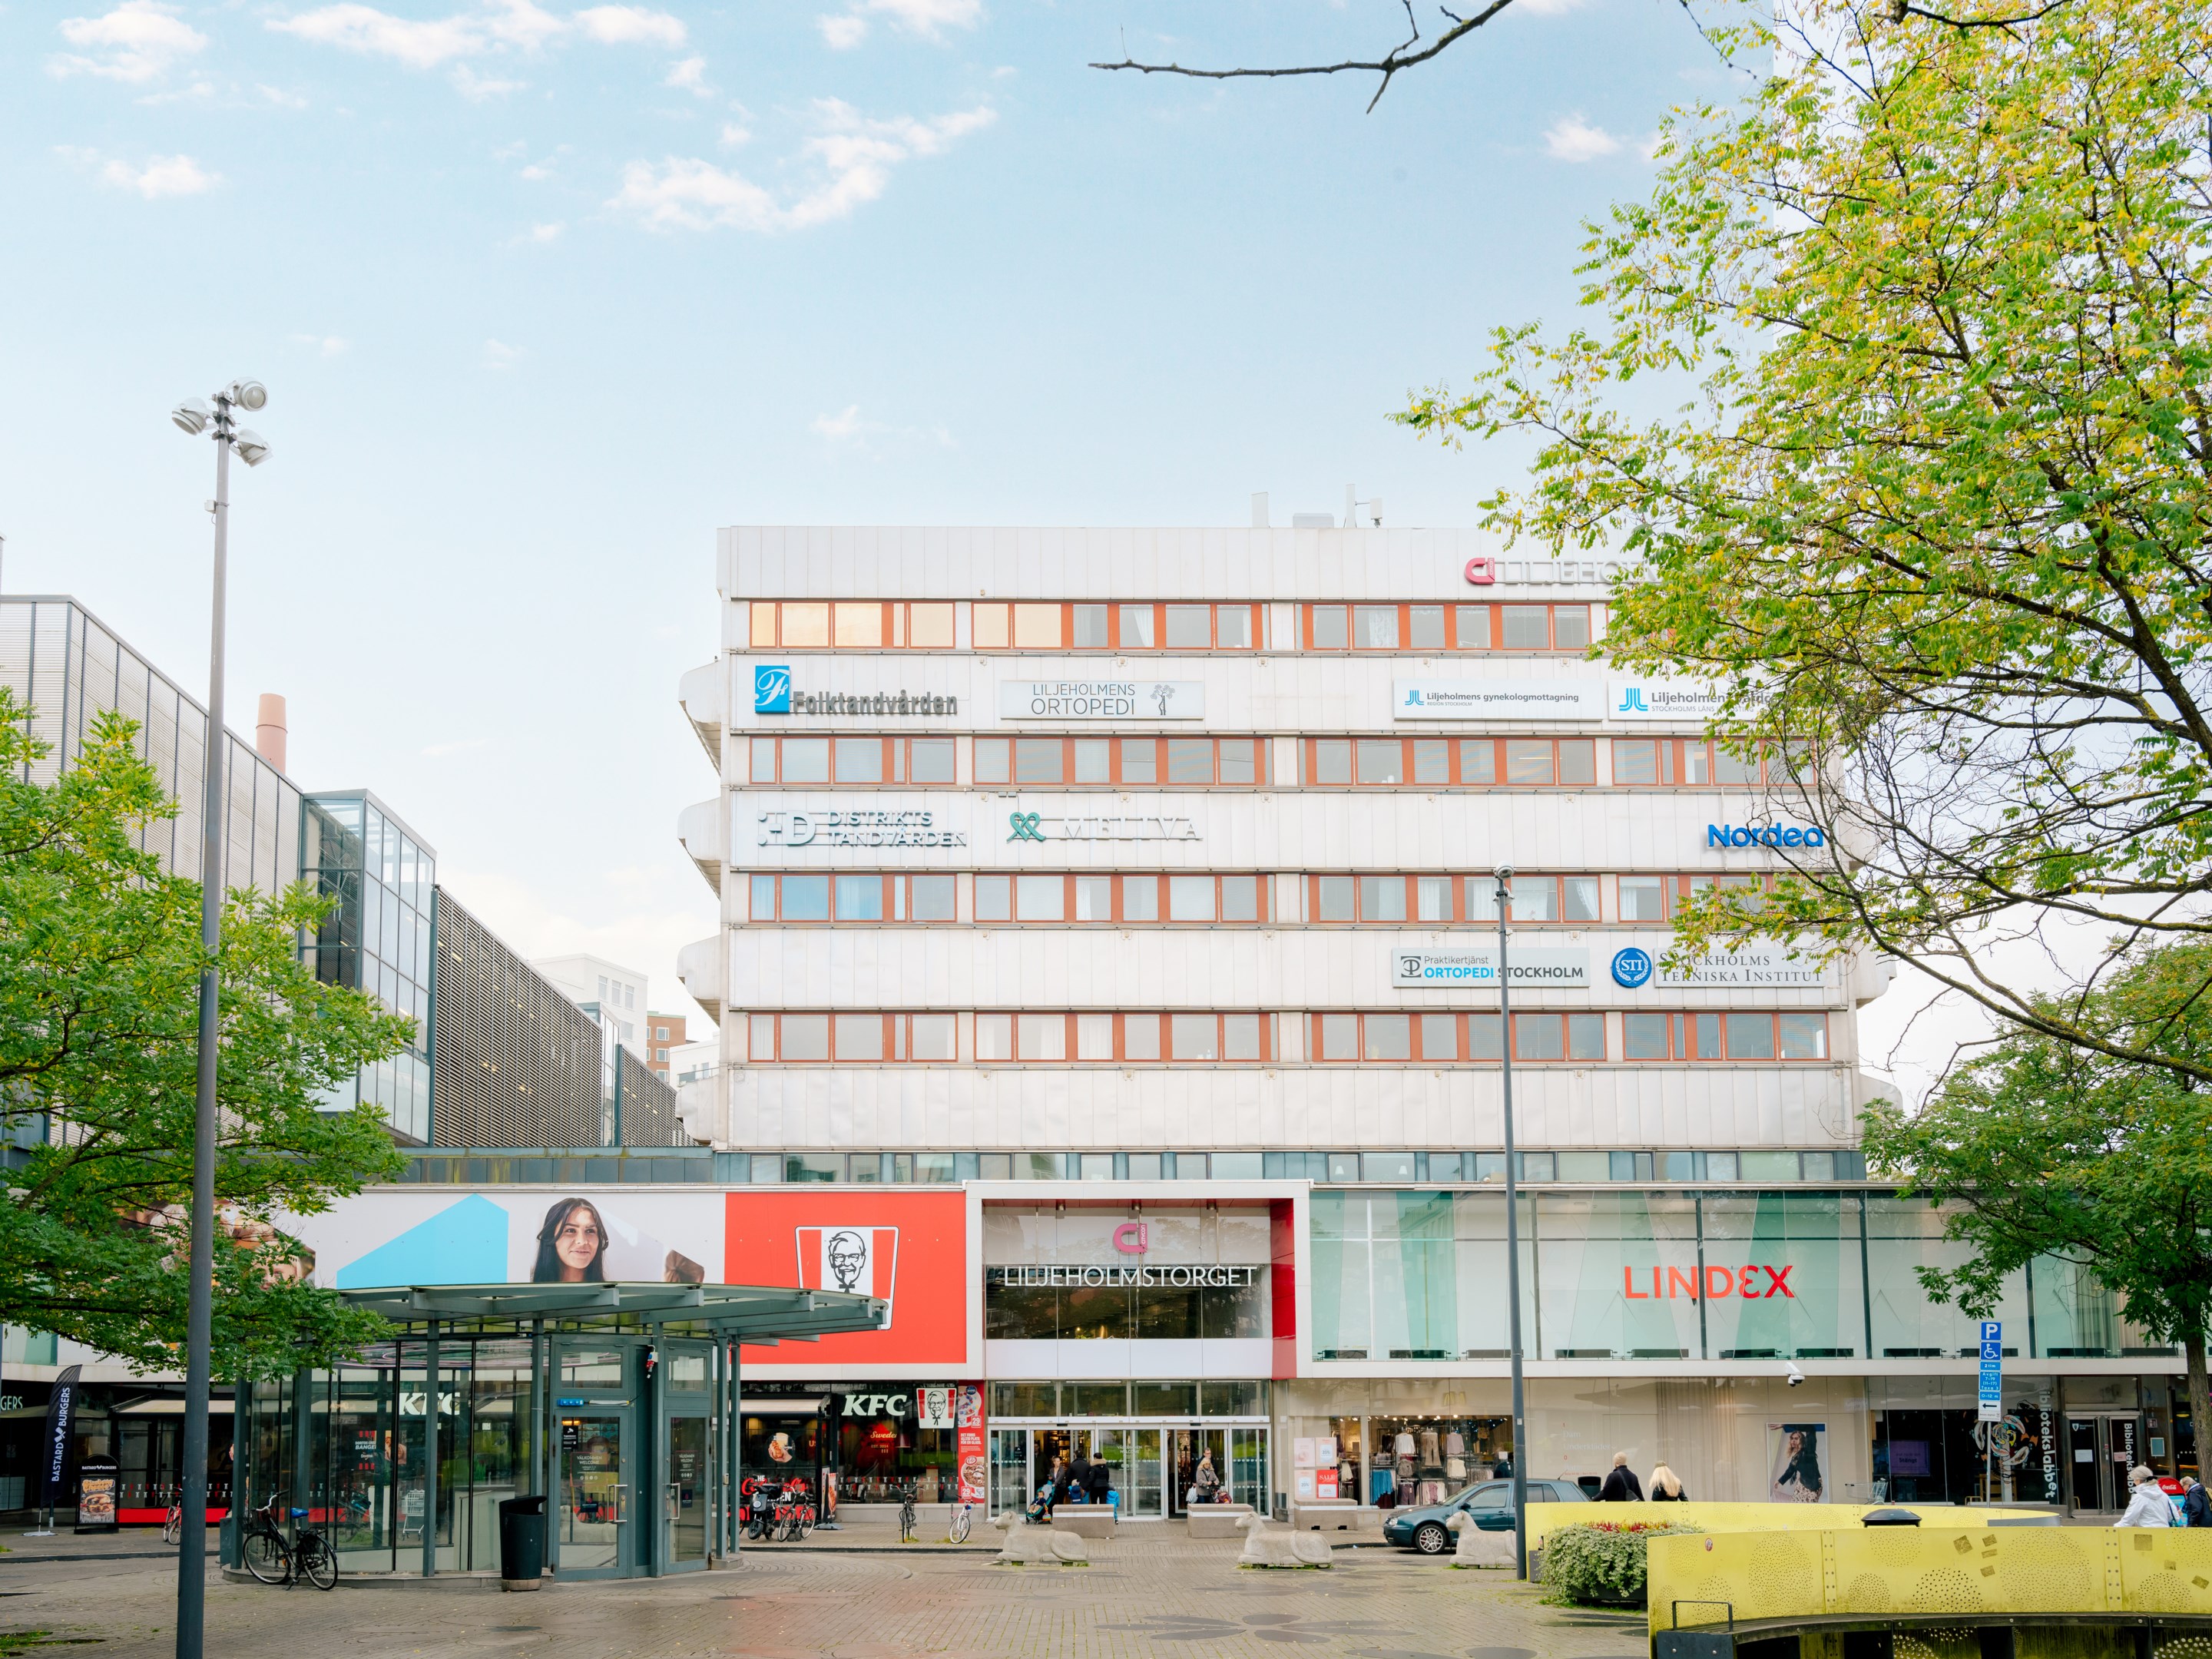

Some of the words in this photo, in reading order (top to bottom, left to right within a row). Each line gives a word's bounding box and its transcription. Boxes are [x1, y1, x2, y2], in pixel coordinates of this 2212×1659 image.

[1033, 684, 1135, 696] LILJEHOLMENS
[1427, 692, 1481, 702] Liljeholmens
[1483, 693, 1579, 703] gynekologmottagning
[793, 689, 958, 715] Folktandvården
[1031, 697, 1134, 715] ORTOPEDI
[827, 810, 933, 827] DISTRIKTS
[829, 827, 968, 847] TANDVÅRDEN
[1061, 816, 1204, 841] MELIVA
[1707, 822, 1824, 848] Nordea
[1424, 955, 1489, 966] Praktikertjänst
[1621, 959, 1644, 972] STI
[1659, 952, 1770, 966] SOCKHOLMS
[1424, 967, 1494, 979] ORTOPEDI
[1744, 969, 1823, 982] INSTITUT
[1004, 1266, 1257, 1287] LILJEHOLMSTORGET
[1624, 1265, 1795, 1300] LINDEX
[1985, 1323, 1998, 1339] P
[841, 1394, 908, 1416] KFC
[51, 1442, 64, 1482] BASTARD
[58, 1387, 71, 1426] BURGERS
